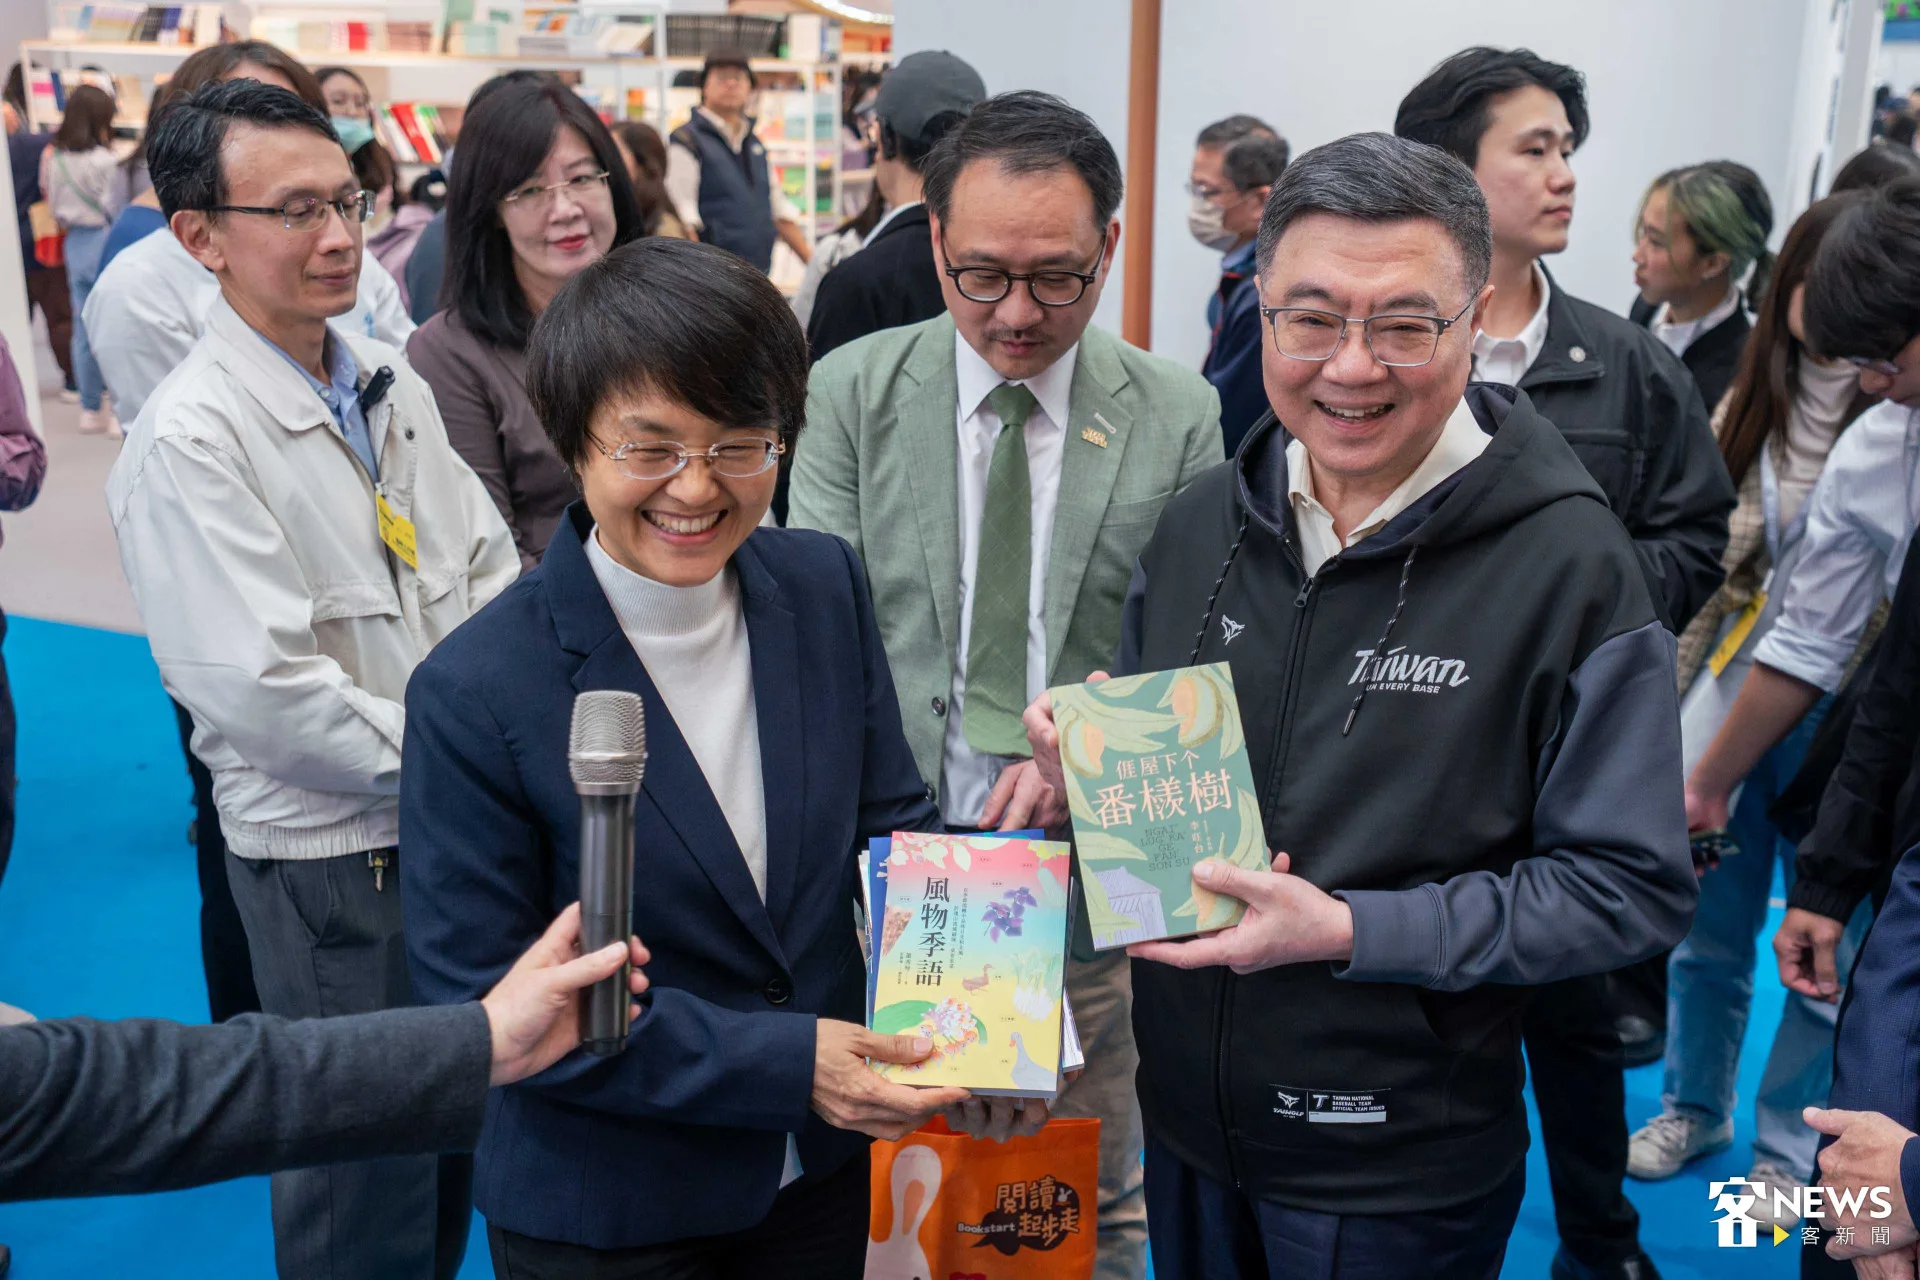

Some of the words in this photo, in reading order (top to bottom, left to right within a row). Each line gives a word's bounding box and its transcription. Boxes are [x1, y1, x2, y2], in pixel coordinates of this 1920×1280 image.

[1379, 682, 1410, 692] EVERY
[1412, 684, 1441, 694] BASE
[915, 876, 951, 987] 風物季語
[996, 1175, 1057, 1215] 閱讀
[957, 1222, 1017, 1235] Bookstart
[1018, 1207, 1080, 1247] 起步走
